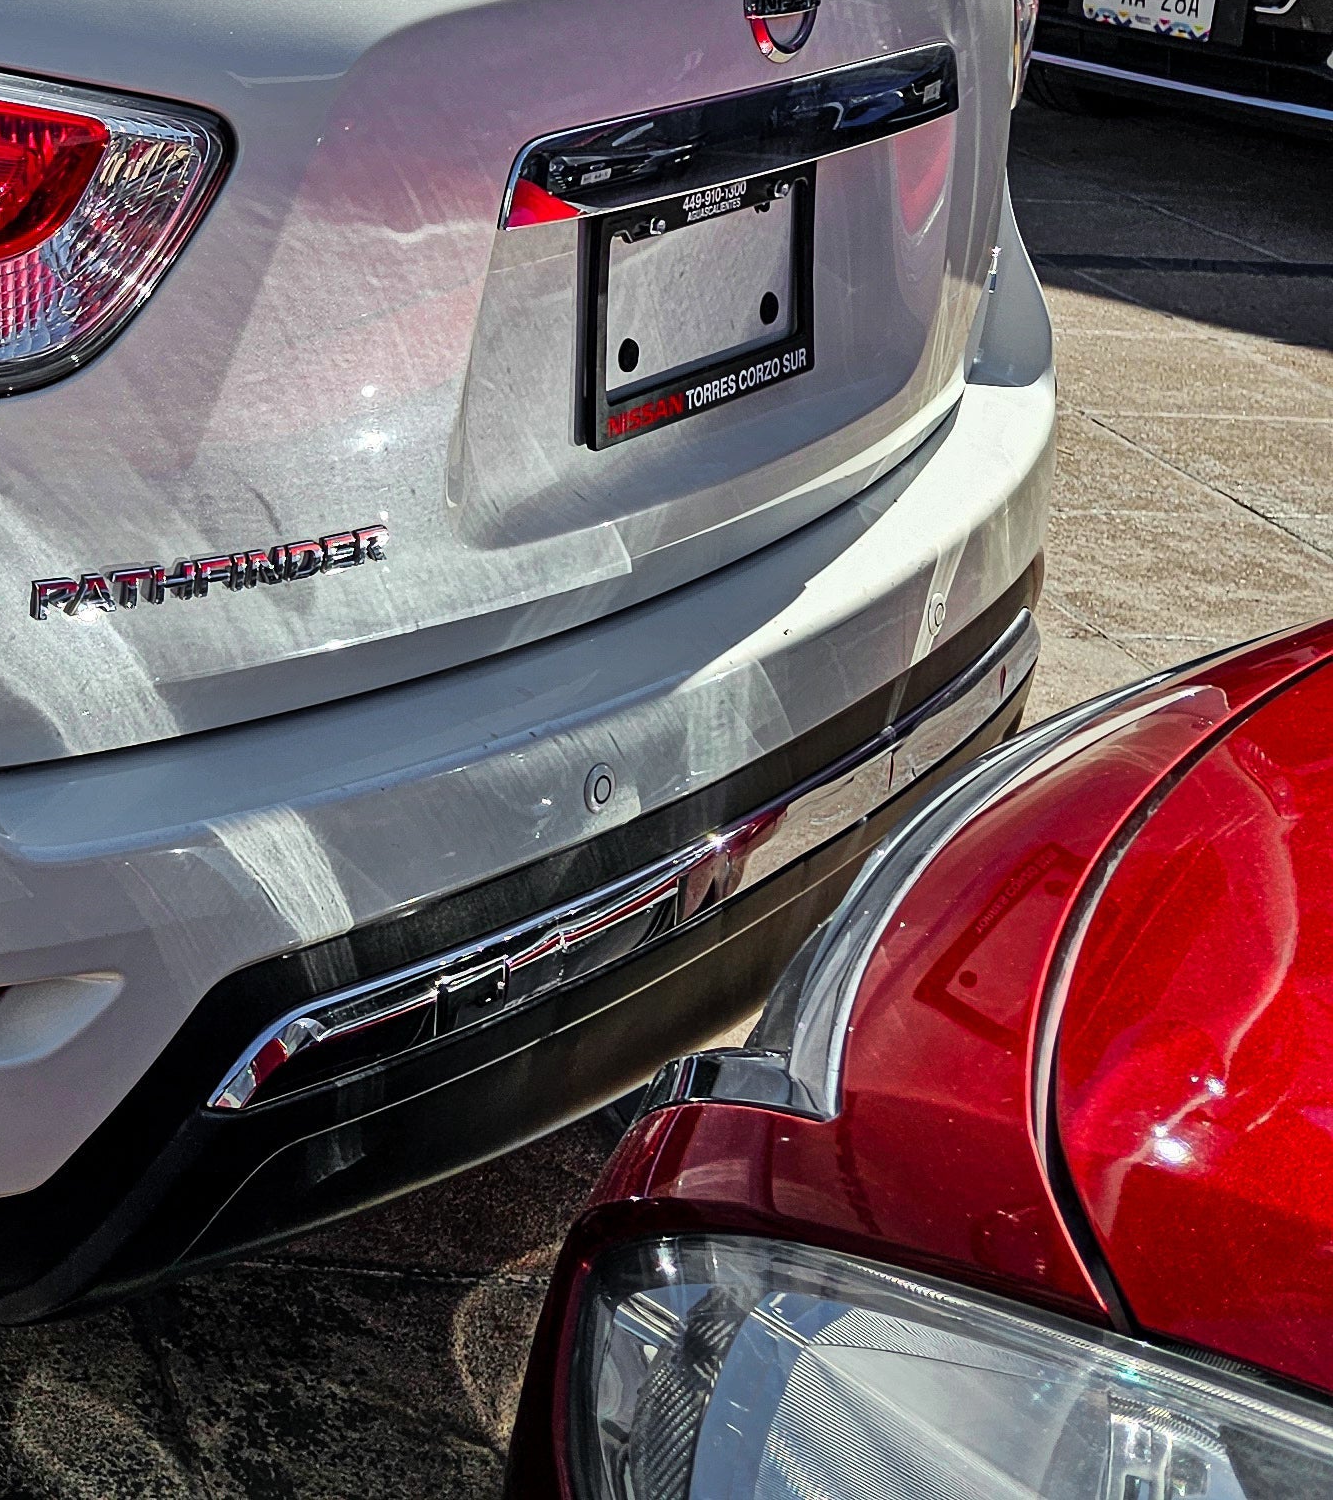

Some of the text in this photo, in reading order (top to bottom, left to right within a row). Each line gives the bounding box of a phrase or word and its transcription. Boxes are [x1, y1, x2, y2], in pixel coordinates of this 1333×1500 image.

[682, 180, 747, 211] 449-910-1300
[686, 197, 741, 222] AGUASCALIENTES
[607, 348, 807, 438] NISSAN TORRES CORZO SUR
[29, 524, 390, 621] PATHFINDER
